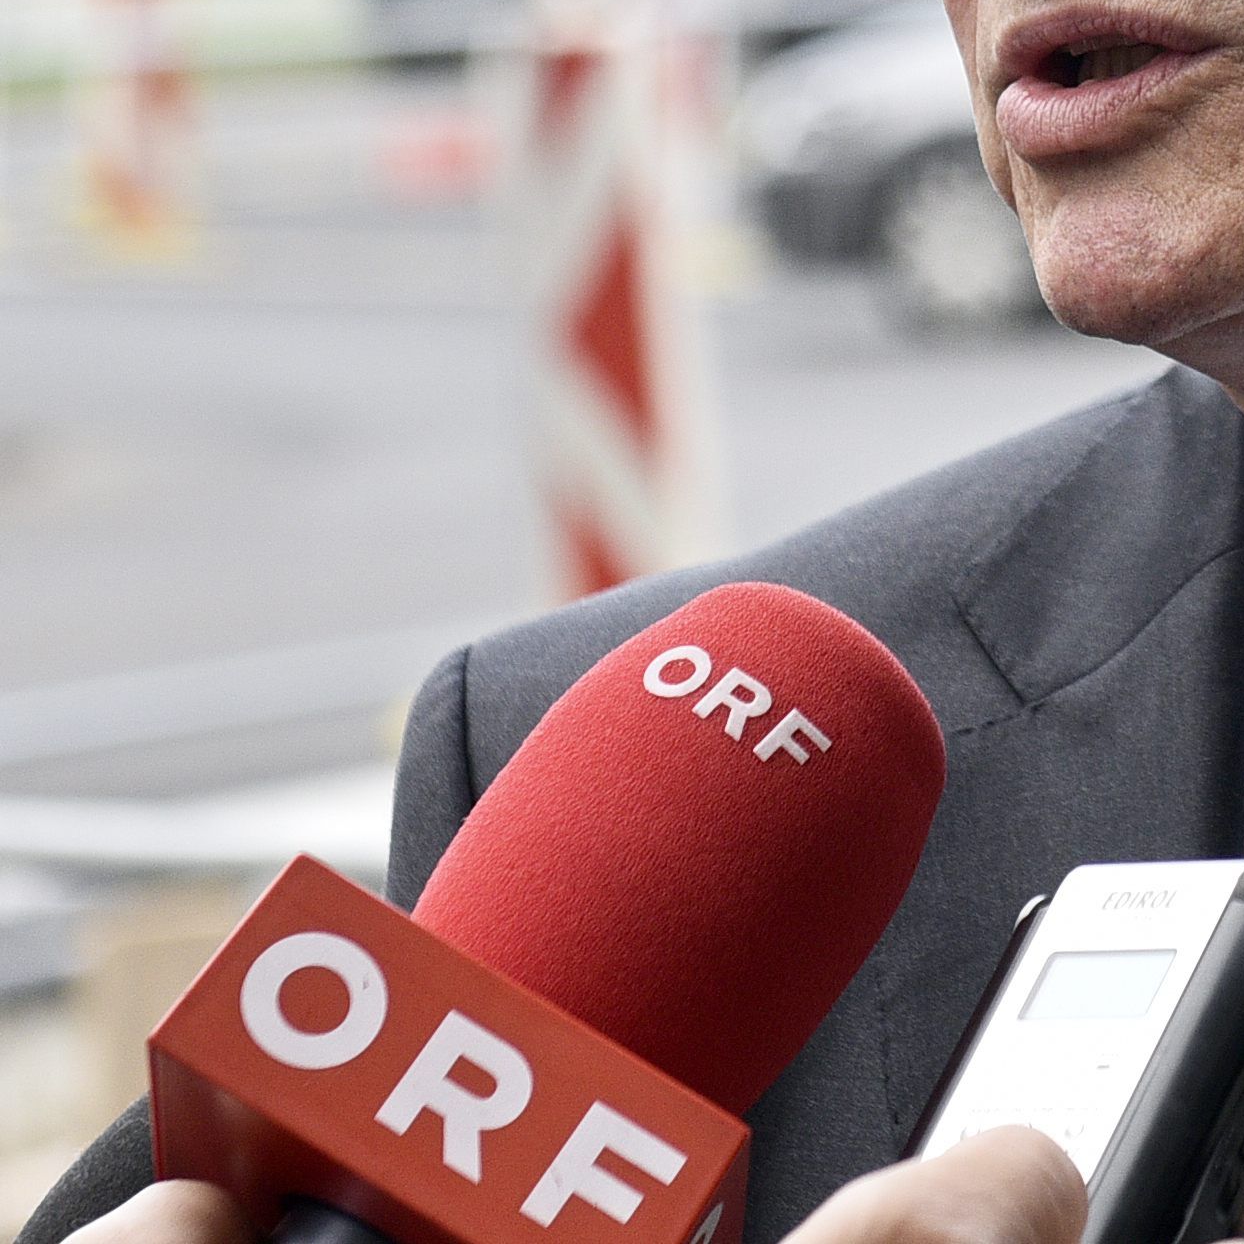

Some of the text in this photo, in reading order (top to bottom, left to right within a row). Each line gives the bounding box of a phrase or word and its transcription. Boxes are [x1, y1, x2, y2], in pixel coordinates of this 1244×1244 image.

[643, 645, 832, 766] ORF
[1101, 890, 1178, 910] EDIROL
[240, 931, 687, 1228] ORF
